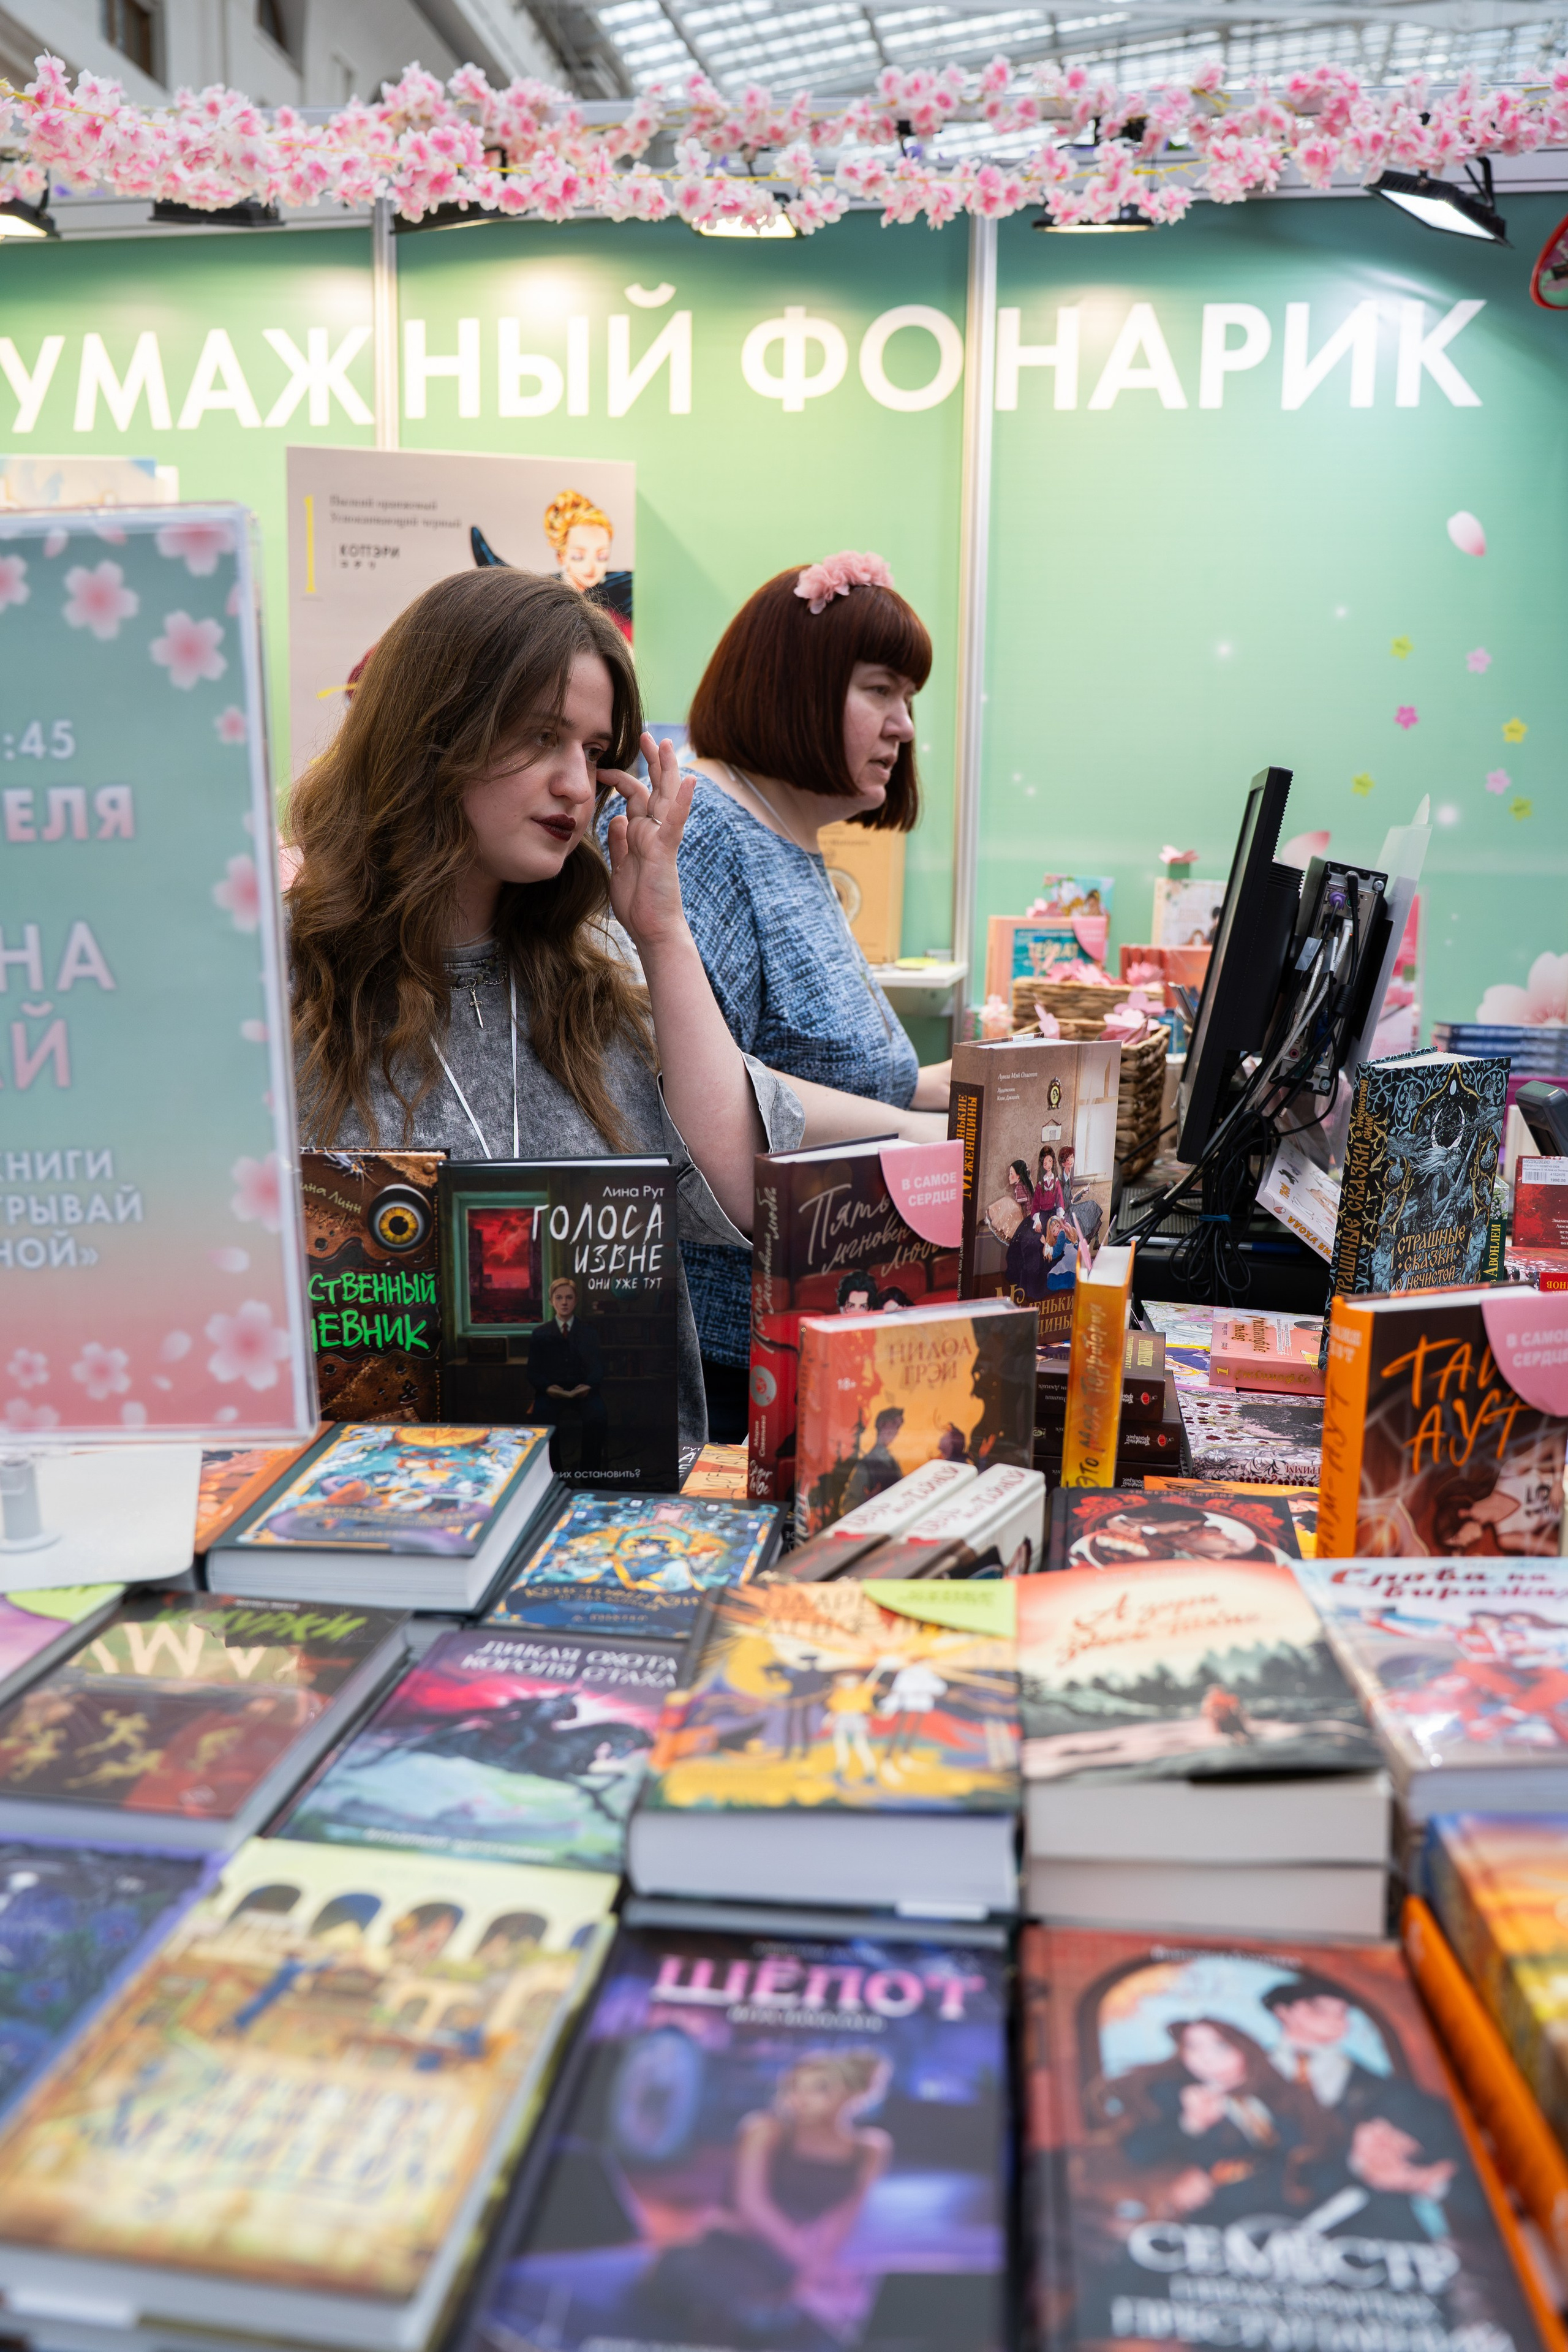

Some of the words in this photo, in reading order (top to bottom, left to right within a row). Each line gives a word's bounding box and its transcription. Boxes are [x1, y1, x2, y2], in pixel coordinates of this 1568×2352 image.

[741, 299, 1487, 412] ФОНАРИК
[0, 1001, 72, 1091] Й
[602, 1186, 639, 1197] Лина
[643, 1185, 665, 1200] Рут
[902, 1178, 911, 1191] В
[913, 1172, 957, 1189] САМОЕ
[0, 1184, 144, 1226] РЫВАЙ
[328, 1191, 362, 1215] Линн
[908, 1188, 957, 1207] СЕРДЦЕ
[532, 1201, 665, 1245] ГОЛОСА
[1287, 1215, 1319, 1245] УХОДА
[821, 1207, 914, 1275] мгновен
[1397, 1225, 1466, 1255] СТРАШНЫЕ
[575, 1243, 664, 1274] ИЗВНЕ
[1404, 1246, 1455, 1273] СКАЗКИ
[588, 1278, 610, 1291] ОНИ
[615, 1277, 638, 1290] УЖЕ
[643, 1277, 663, 1290] ТУТ
[1401, 1388, 1531, 1474] АУТ
[650, 1953, 988, 2021] ШЁПОТ
